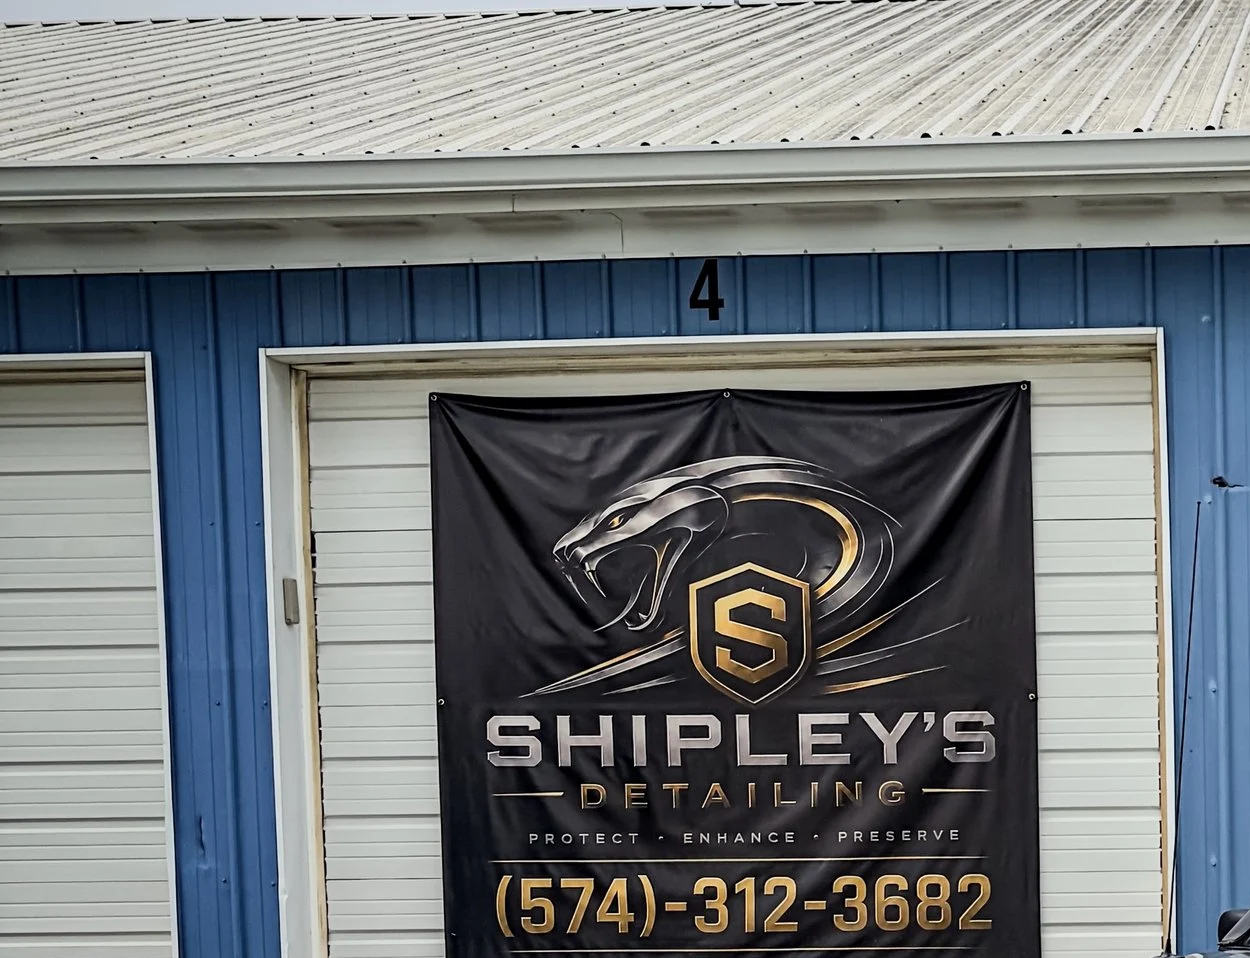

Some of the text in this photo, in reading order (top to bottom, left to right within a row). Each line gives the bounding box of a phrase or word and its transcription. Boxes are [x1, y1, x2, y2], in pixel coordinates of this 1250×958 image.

[689, 258, 725, 321] 4
[714, 588, 788, 684] S
[486, 710, 996, 768] SHIPLEY'S
[580, 780, 906, 810] DETAILING
[528, 828, 961, 846] PROTECT ENHANCE PRESERVE
[495, 873, 993, 938] (574)-312-3682
